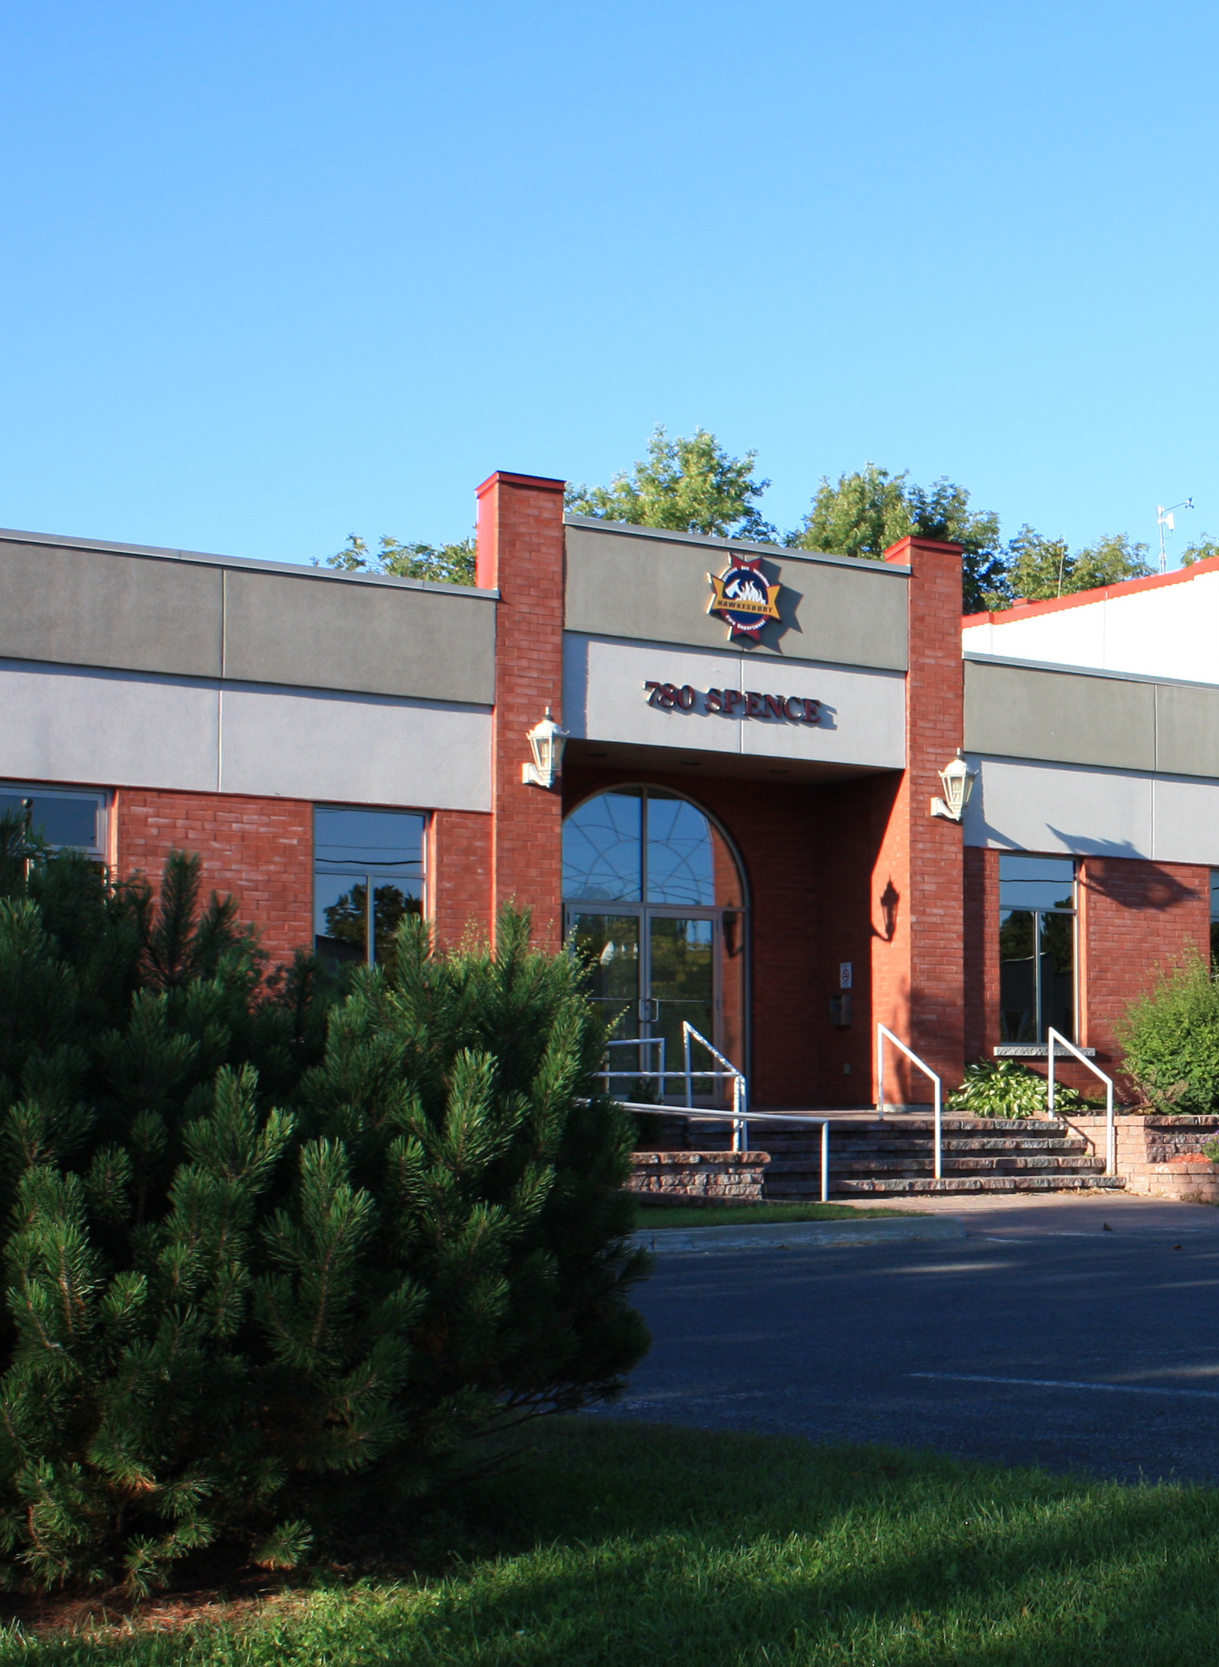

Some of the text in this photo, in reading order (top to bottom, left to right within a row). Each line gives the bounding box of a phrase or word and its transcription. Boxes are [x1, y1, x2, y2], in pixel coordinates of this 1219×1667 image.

[717, 600, 774, 613] HAWKESBURY
[642, 680, 822, 724] 780 SPENCE
